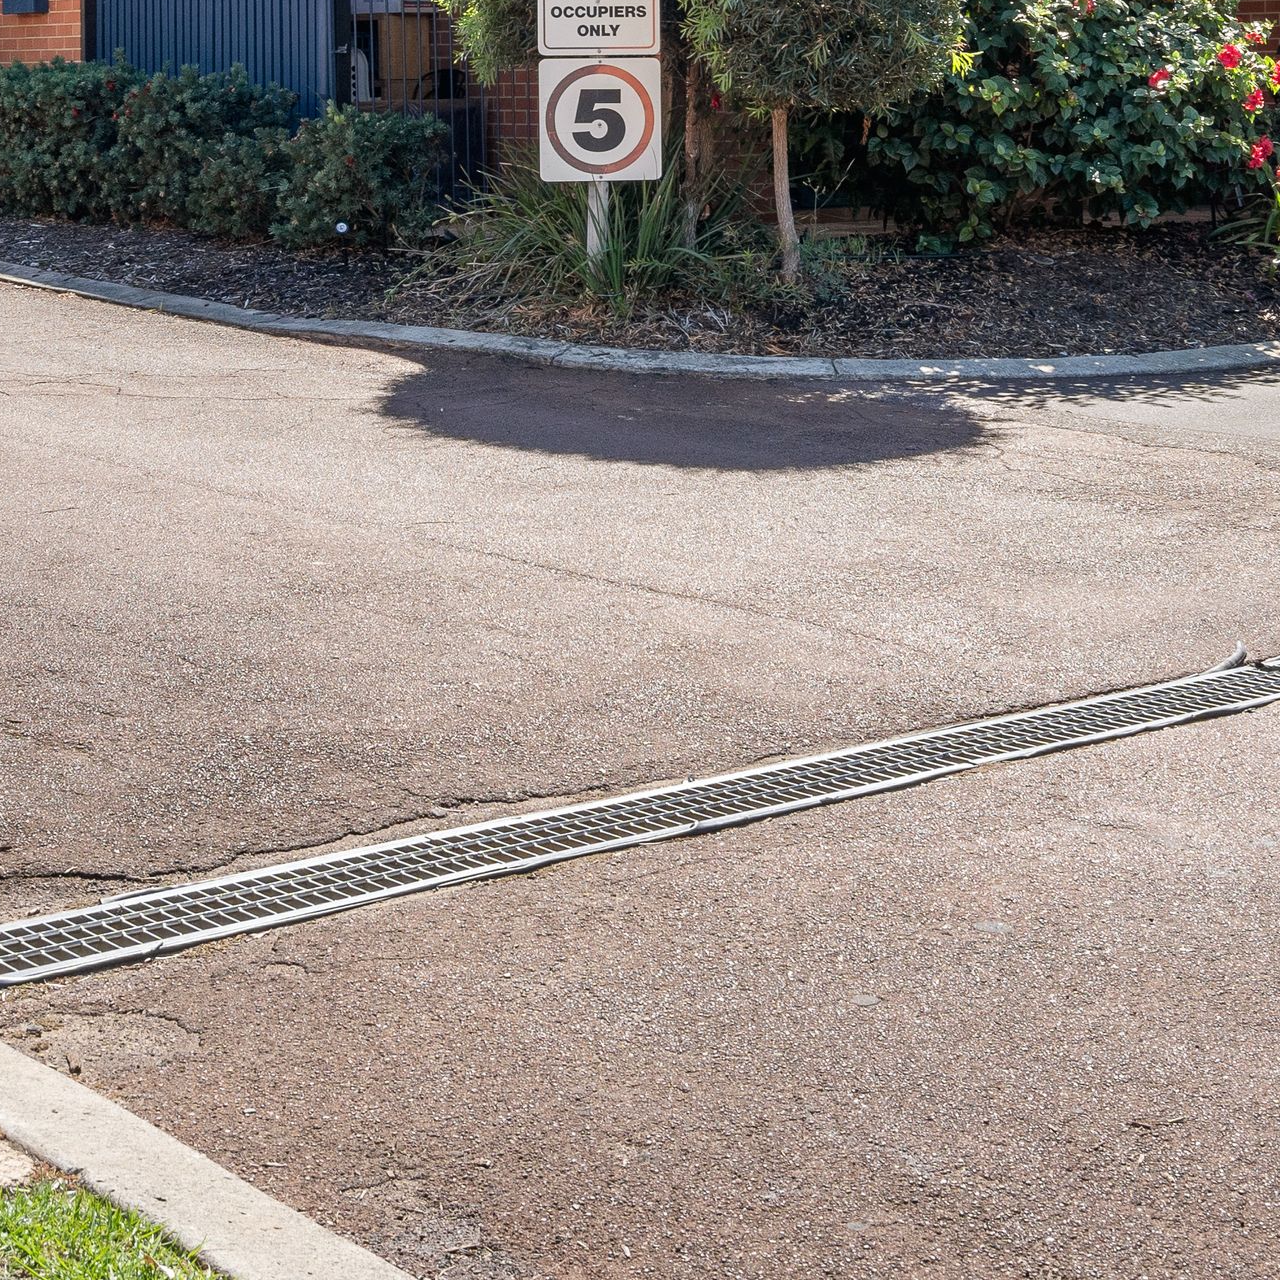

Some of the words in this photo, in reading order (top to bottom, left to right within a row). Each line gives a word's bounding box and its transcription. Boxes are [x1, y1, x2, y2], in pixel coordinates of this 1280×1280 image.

[550, 5, 647, 18] OCCUPIERS
[577, 24, 620, 37] ONLY
[572, 89, 626, 152] 5
